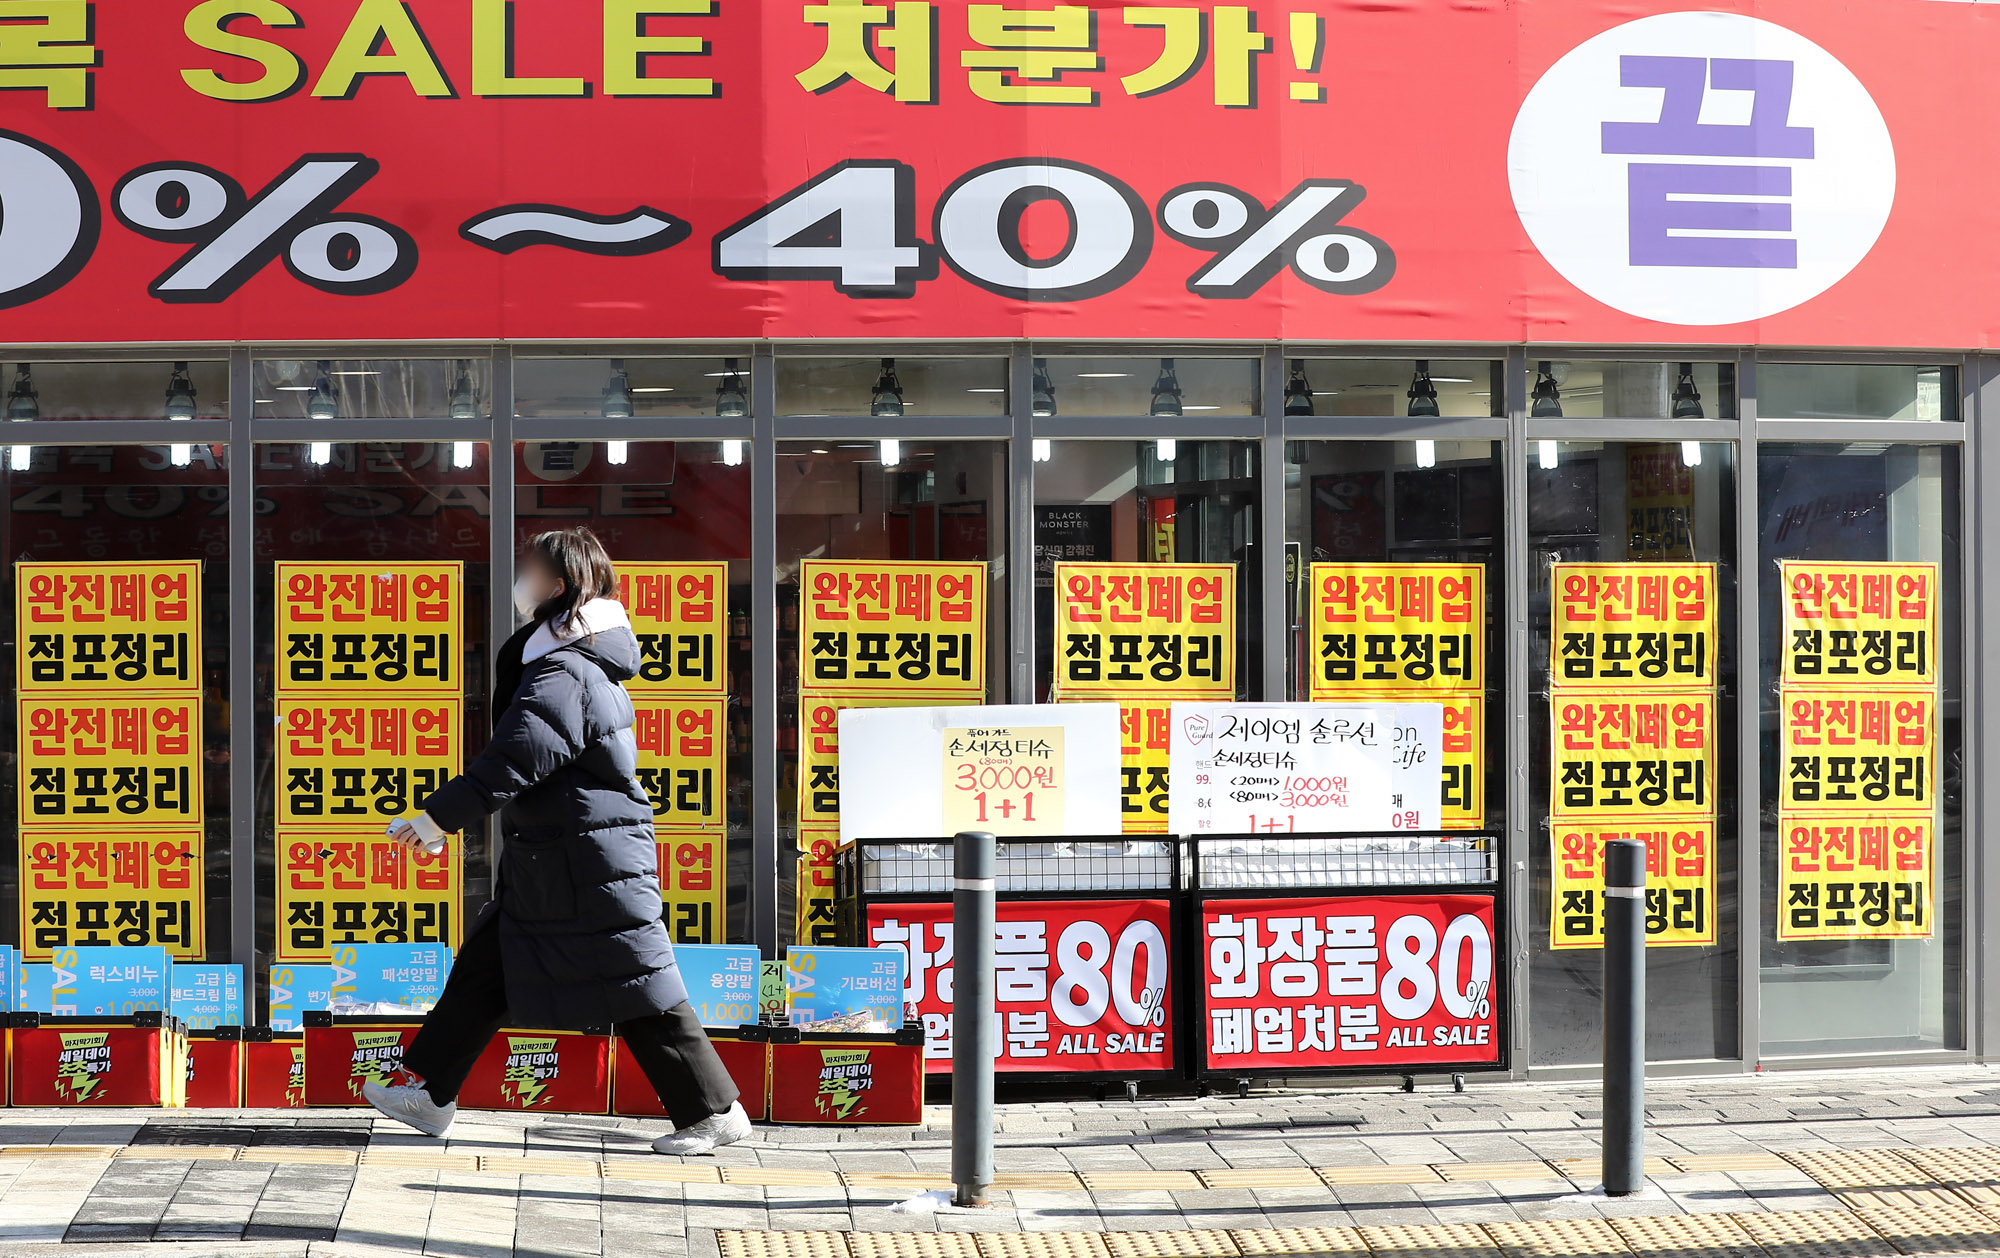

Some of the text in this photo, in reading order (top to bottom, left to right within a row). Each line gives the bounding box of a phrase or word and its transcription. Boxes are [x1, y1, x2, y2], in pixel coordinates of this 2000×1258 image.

[180, 0, 718, 100] SALE
[794, 0, 1326, 107] 처분가!
[1601, 55, 1815, 269] 끝
[1048, 512, 1081, 520] BLACK
[28, 573, 188, 623] 완전폐업
[287, 573, 449, 623] 완전폐업
[614, 574, 713, 622] 폐업
[812, 572, 972, 622] 완전폐업
[1066, 575, 1222, 623] 완전폐업
[1321, 575, 1472, 623] 완전폐업
[1562, 574, 1705, 622] 완전폐업
[1792, 573, 1926, 619] 완전폐업
[28, 633, 188, 681] 점포정리
[287, 633, 449, 682] 점포정리
[637, 634, 713, 682] 정리
[811, 631, 971, 681] 점포정리
[1066, 633, 1222, 681] 점포정리
[1321, 633, 1472, 681] 점포정리
[1561, 632, 1705, 678] 점포정리
[1792, 629, 1926, 675] 점포정리
[29, 707, 189, 756] 완전폐업
[287, 707, 449, 757] 완전폐업
[635, 709, 713, 756] 폐업
[967, 729, 1011, 737] 퓨어 가드
[1218, 715, 1378, 746] 제이엠 솔루션
[1561, 703, 1704, 750] 완전폐업
[1790, 700, 1925, 746] 완전폐업
[979, 757, 1013, 765] (80매)
[1561, 759, 1705, 807] 점포정리
[1790, 756, 1925, 802] 점포정리
[29, 766, 190, 815] 점포정리
[287, 767, 449, 816] 점포정리
[635, 768, 713, 816] 정리
[973, 792, 1036, 822] 1+1
[1121, 767, 1170, 813] 포정
[1249, 814, 1295, 833] 1+1
[31, 841, 190, 890] 완전폐업
[287, 842, 449, 891] 완전폐업
[1562, 831, 1704, 879] 완폐업
[1788, 825, 1923, 872] 완전폐업
[31, 900, 191, 948] 점포정리
[287, 901, 449, 948] 점포정리
[1562, 887, 1704, 936] 점정리
[1788, 881, 1923, 928] 점포정리
[89, 966, 159, 983] 럭스비누
[194, 973, 220, 987] 고급
[331, 946, 357, 1003] SAL
[382, 967, 438, 983] 패션양말
[409, 951, 438, 965] 고급
[710, 973, 753, 988] 융양말
[724, 957, 753, 972] 고급
[871, 962, 897, 975] 고급
[1051, 919, 1169, 1028] 80%
[1208, 913, 1493, 1021] 화장품 80%
[52, 949, 78, 1016] SALE
[129, 988, 158, 998] 3,000
[171, 988, 220, 1002] 핸드크림
[269, 968, 293, 1031] SALE
[308, 991, 331, 1003] 변기
[408, 984, 438, 995] 2,500
[723, 992, 752, 1001] 3,000
[790, 953, 816, 1025] SALE
[841, 977, 897, 991] 기모버선
[867, 995, 897, 1004] 3,000
[192, 1005, 220, 1014] 4,000
[701, 1003, 752, 1021] 1,000
[1210, 1004, 1379, 1054] 폐업처분
[58, 1046, 111, 1062] 세일데이
[351, 1045, 404, 1062] 세일데이
[922, 1011, 1050, 1059] 업분
[1056, 1032, 1166, 1055] ALL SALE
[1386, 1024, 1491, 1048] ALL SALE
[505, 1052, 559, 1067] 세일데이
[819, 1063, 872, 1080] 세일데이
